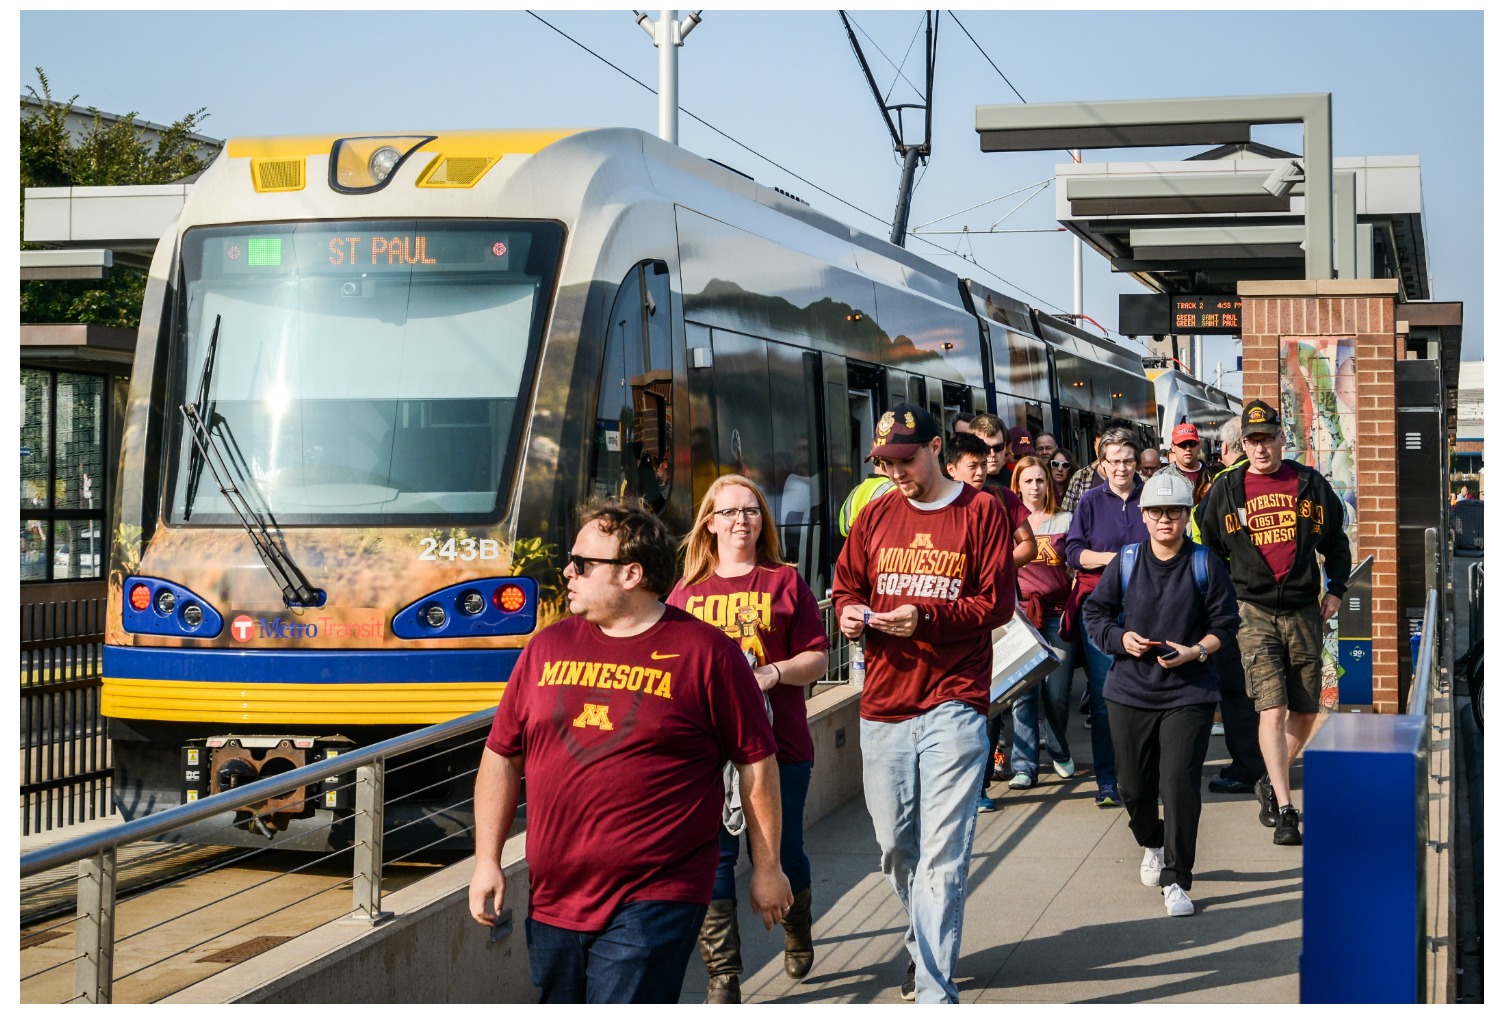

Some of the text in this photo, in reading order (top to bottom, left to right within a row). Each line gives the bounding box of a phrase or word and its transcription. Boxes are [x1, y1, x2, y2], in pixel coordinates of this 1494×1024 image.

[328, 235, 437, 265] ST PAUL
[1176, 302, 1197, 310] TRACK
[1245, 493, 1294, 515] IVERSITY
[1255, 516, 1275, 528] 1851
[417, 537, 499, 562] 243B
[876, 547, 967, 578] MINNESOTA
[876, 573, 963, 601] GOPHERS
[258, 617, 318, 640] Metro
[318, 616, 384, 640] Transit
[537, 660, 673, 699] MINNESOTA
[572, 702, 614, 731] M
